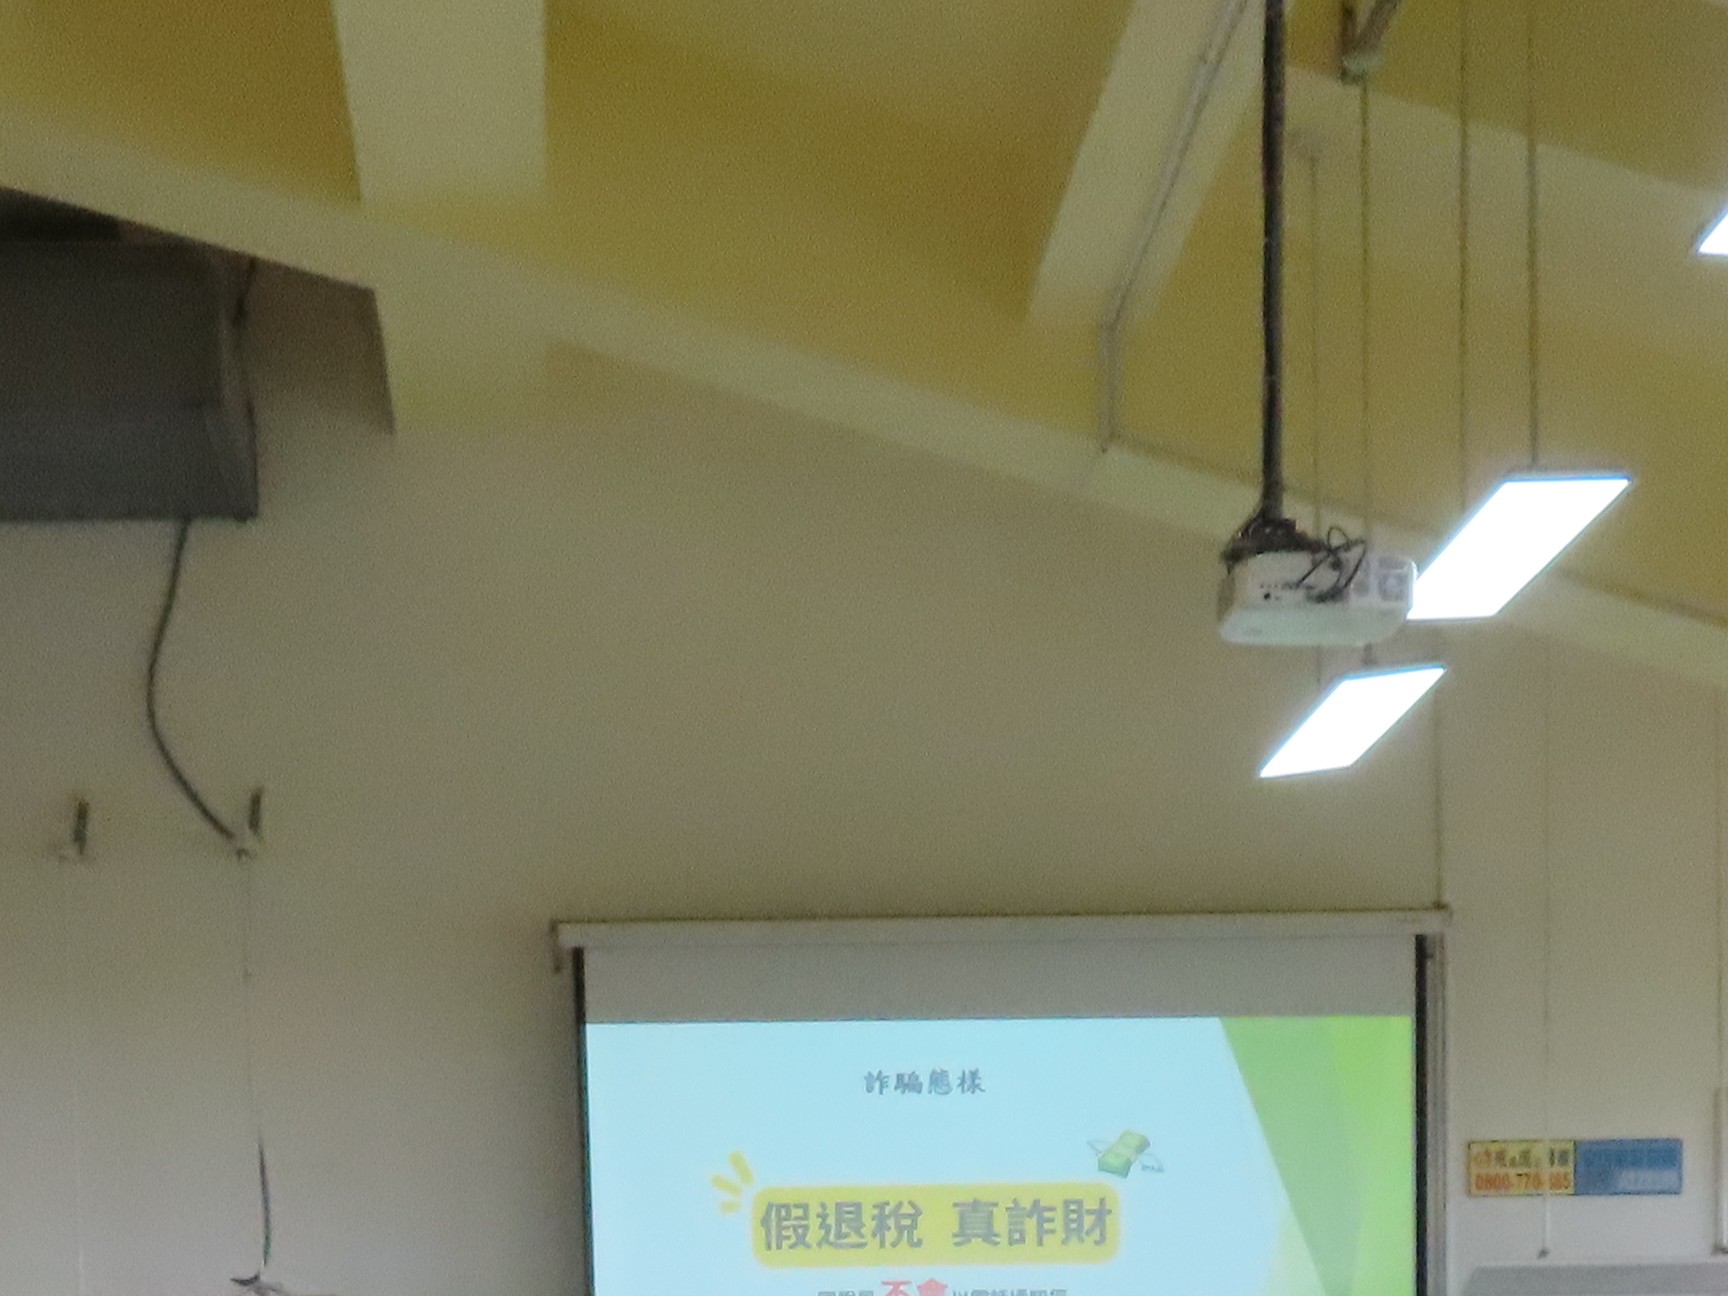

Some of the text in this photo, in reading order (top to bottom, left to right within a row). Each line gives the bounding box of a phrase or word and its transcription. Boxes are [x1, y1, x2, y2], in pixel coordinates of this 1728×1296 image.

[863, 1069, 986, 1096] 詐騙態樣
[760, 1197, 1114, 1250] 假退稅 真詐財
